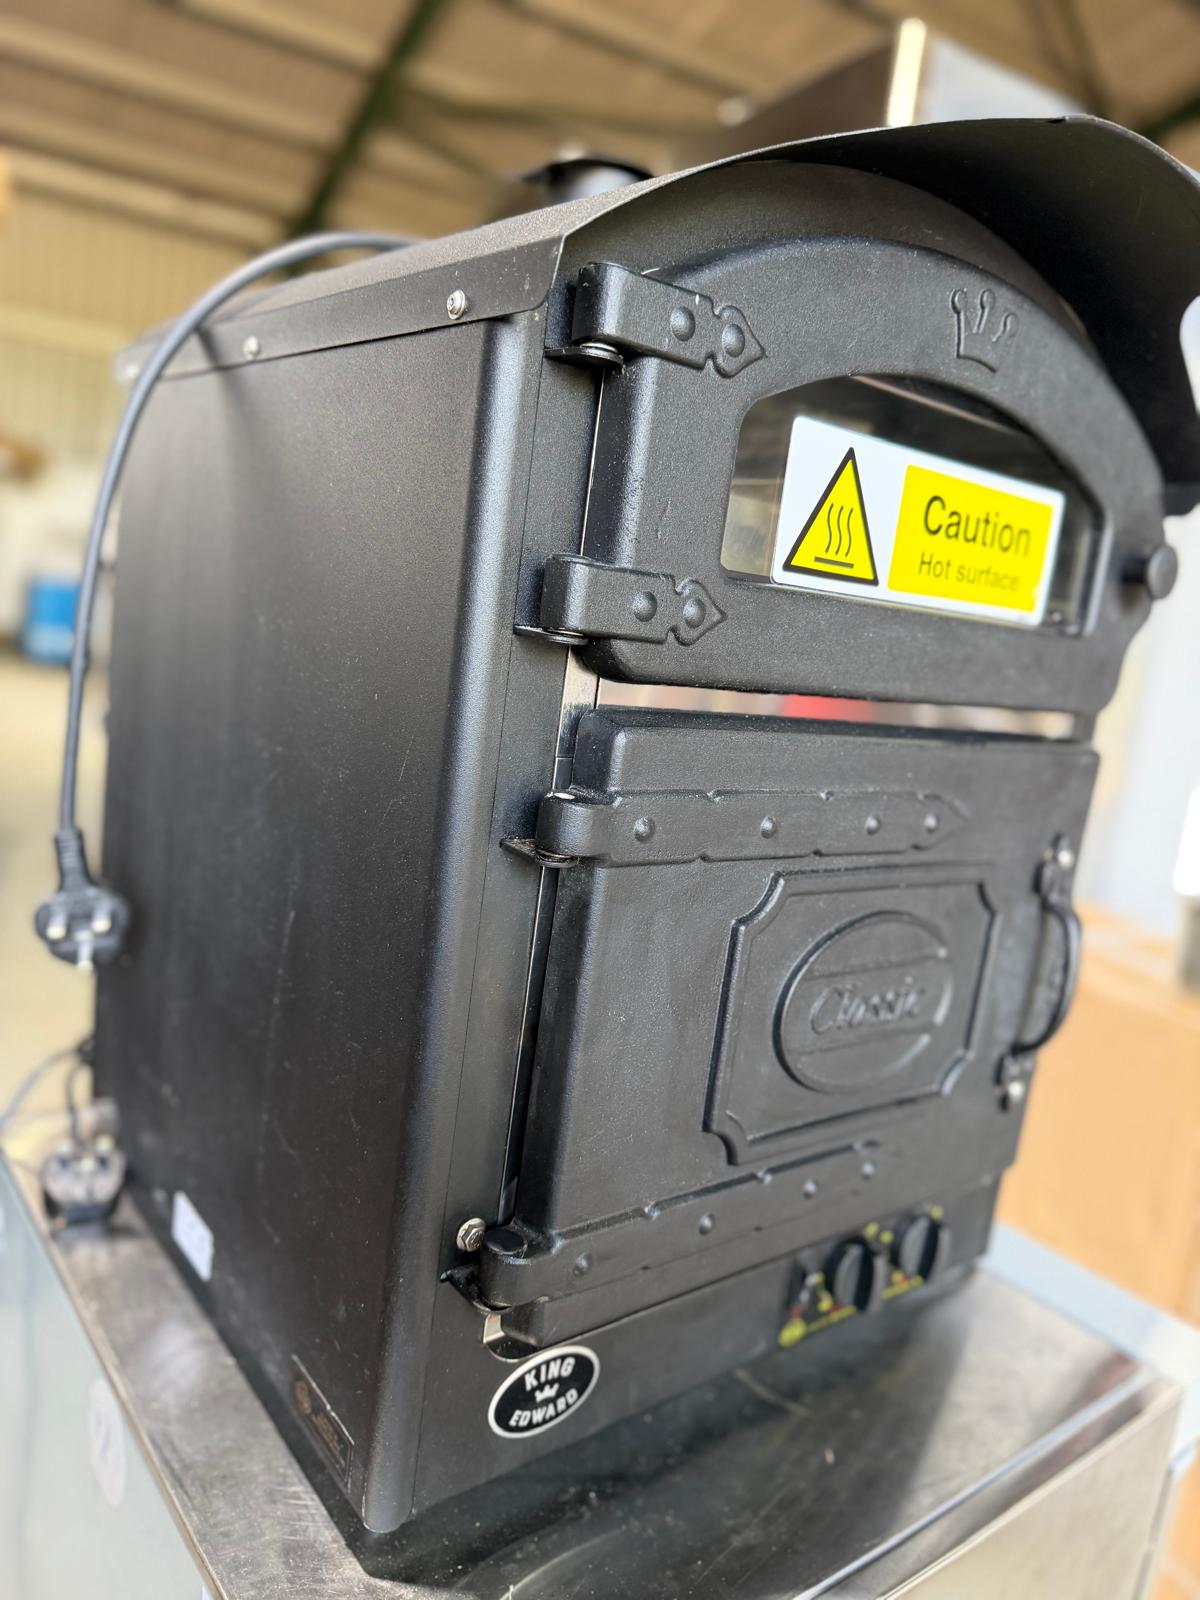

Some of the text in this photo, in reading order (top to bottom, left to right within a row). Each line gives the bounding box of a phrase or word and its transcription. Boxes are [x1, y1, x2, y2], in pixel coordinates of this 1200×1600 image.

[924, 495, 1031, 557] Caution
[918, 552, 1020, 592] Hot surface
[810, 977, 925, 1035] Classic
[524, 1357, 576, 1391] KING
[509, 1388, 578, 1427] EDWARD
